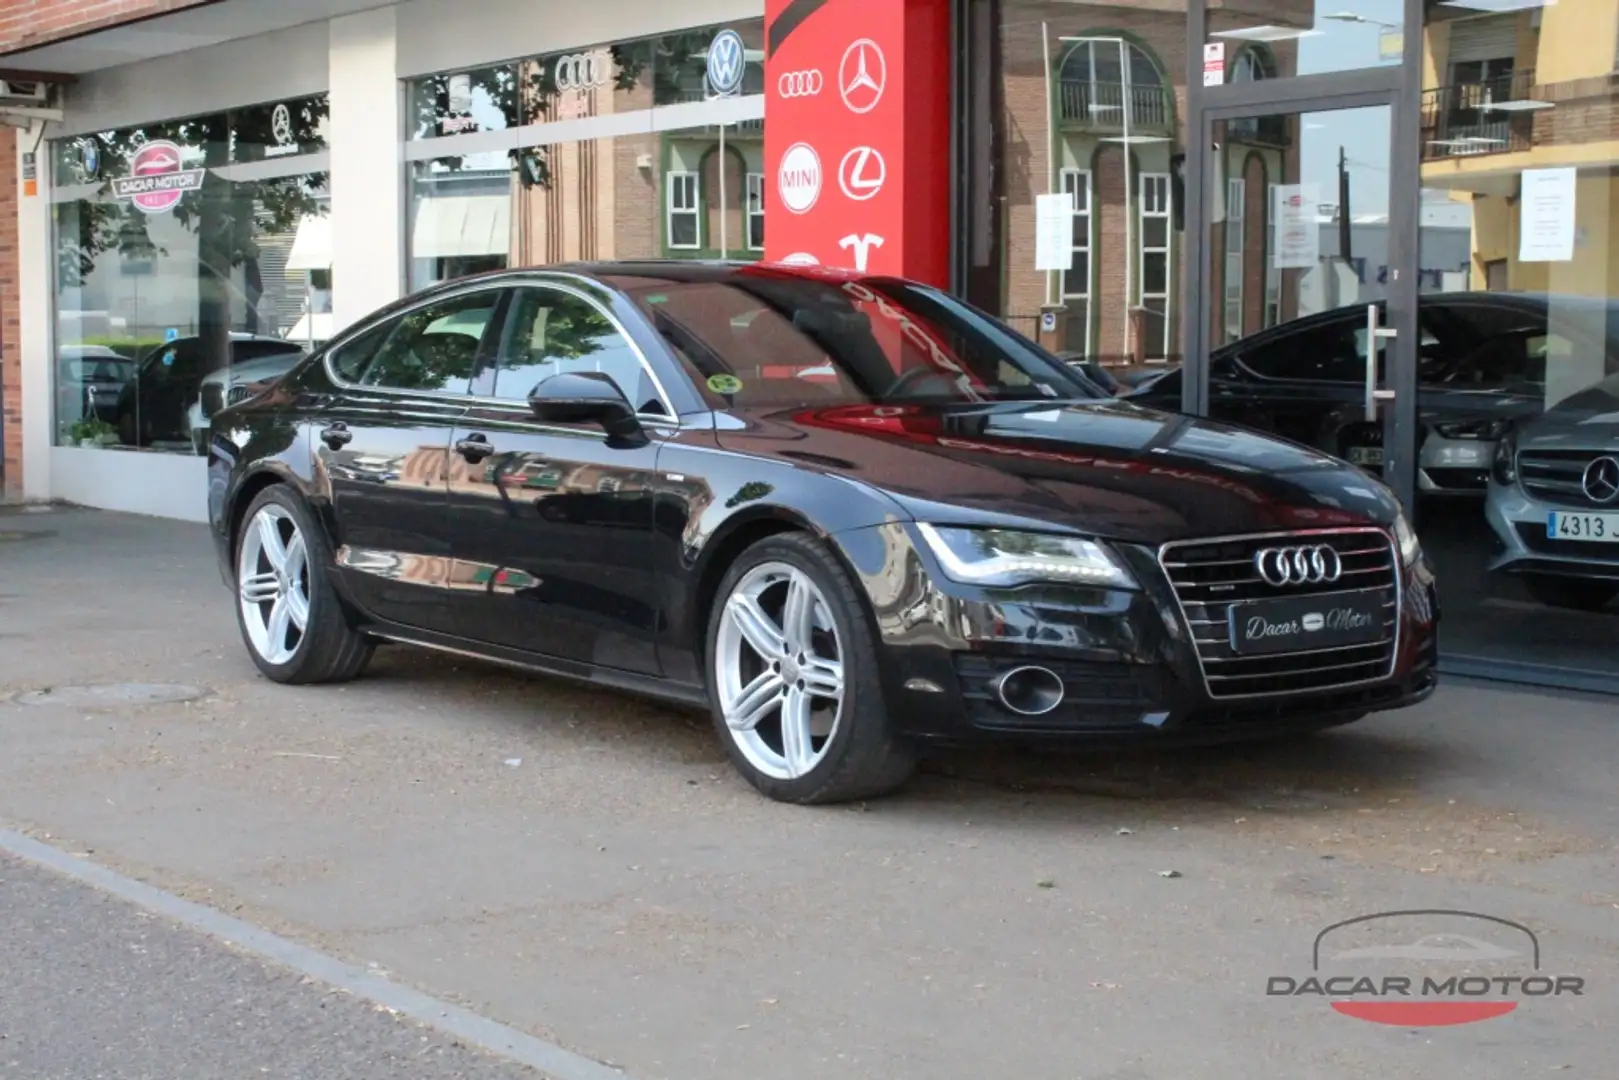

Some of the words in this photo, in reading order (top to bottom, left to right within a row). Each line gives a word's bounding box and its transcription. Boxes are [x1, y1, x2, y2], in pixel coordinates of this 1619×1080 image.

[120, 179, 154, 193] DACAR
[154, 173, 195, 189] MOTOR
[783, 168, 817, 188] MINI
[1560, 515, 1605, 537] 4313
[1246, 616, 1300, 640] Dacar
[1326, 607, 1373, 631] Motor
